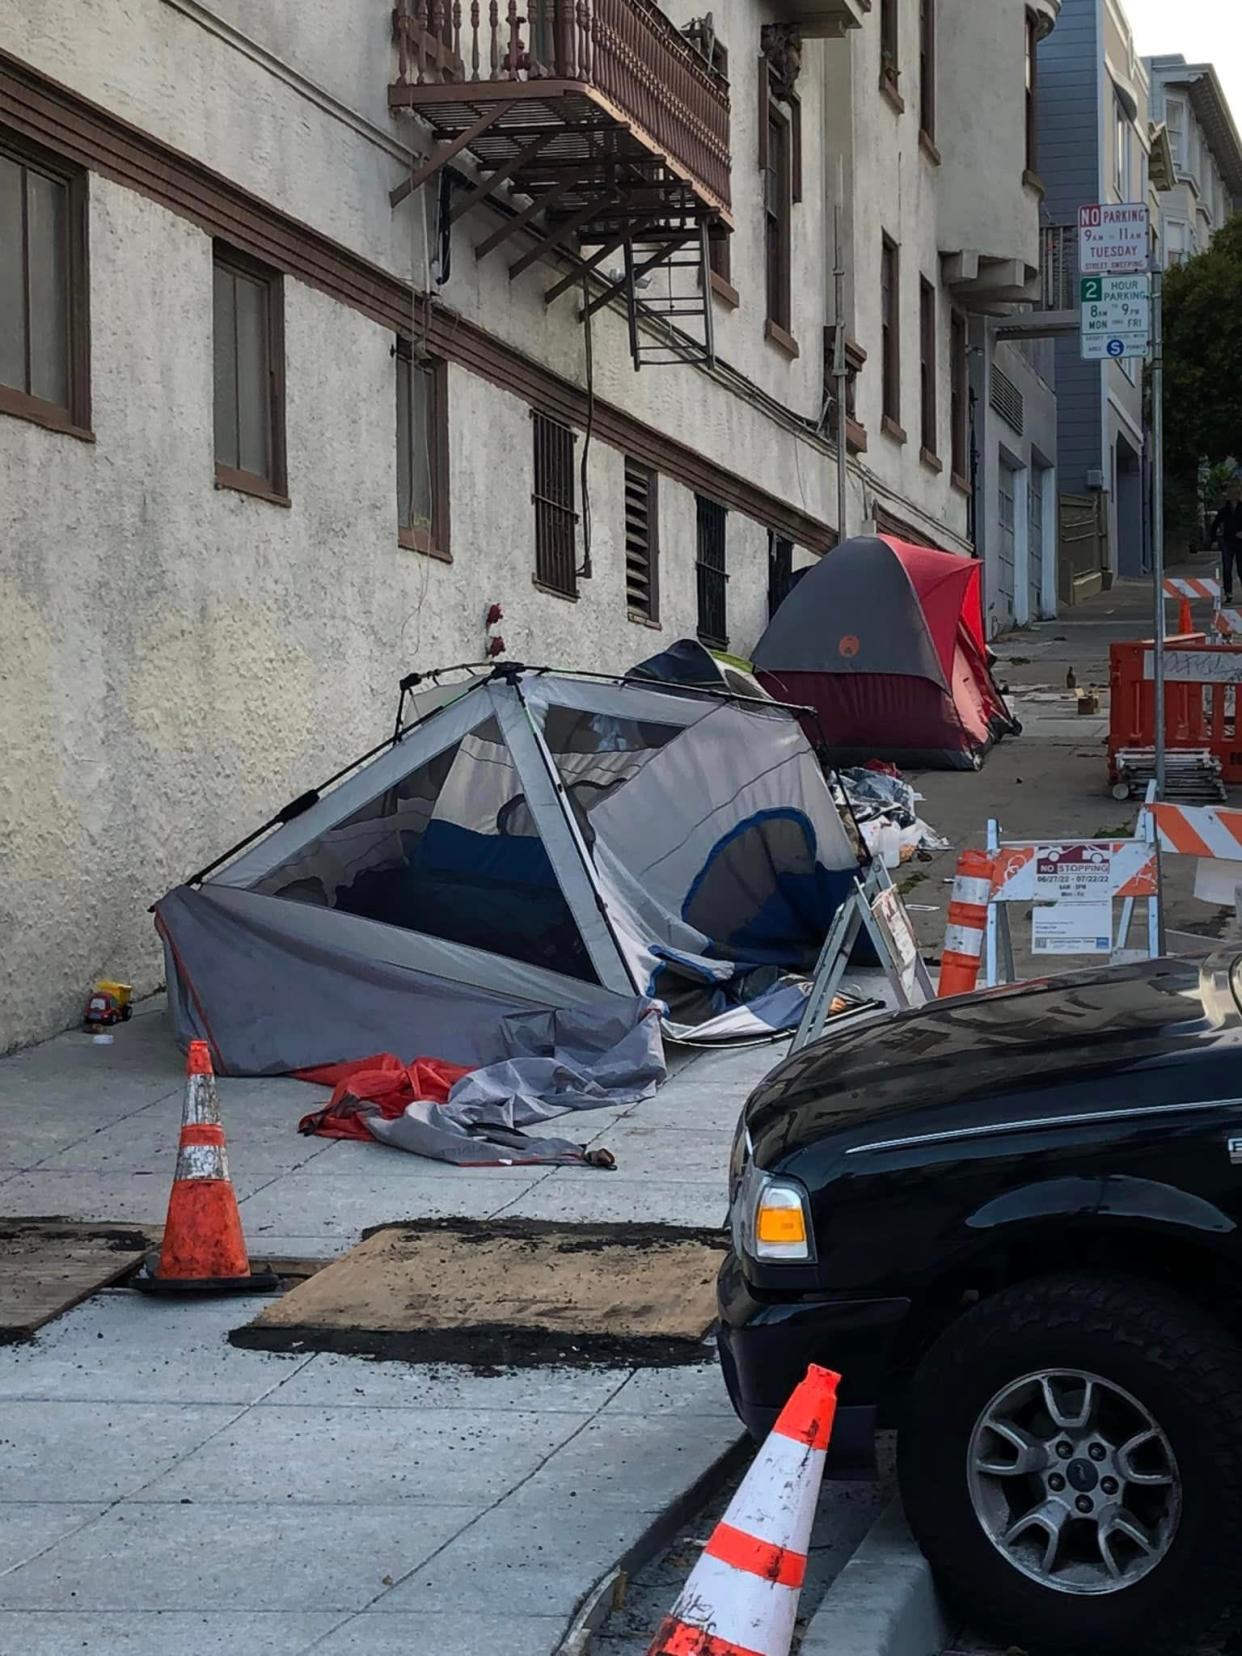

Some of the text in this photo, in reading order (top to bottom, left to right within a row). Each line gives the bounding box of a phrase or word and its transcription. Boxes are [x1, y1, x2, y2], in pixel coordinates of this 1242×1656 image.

[1081, 208, 1145, 225] NO PARKING
[1090, 245, 1138, 257] TUESDAY
[1085, 281, 1098, 299] 2
[1111, 280, 1138, 290] HOUR
[1104, 291, 1146, 302] PARKING
[1089, 319, 1107, 330] MON
[1127, 317, 1142, 328] FRI
[1110, 341, 1121, 355] S
[1040, 864, 1108, 873] NO STOPPING
